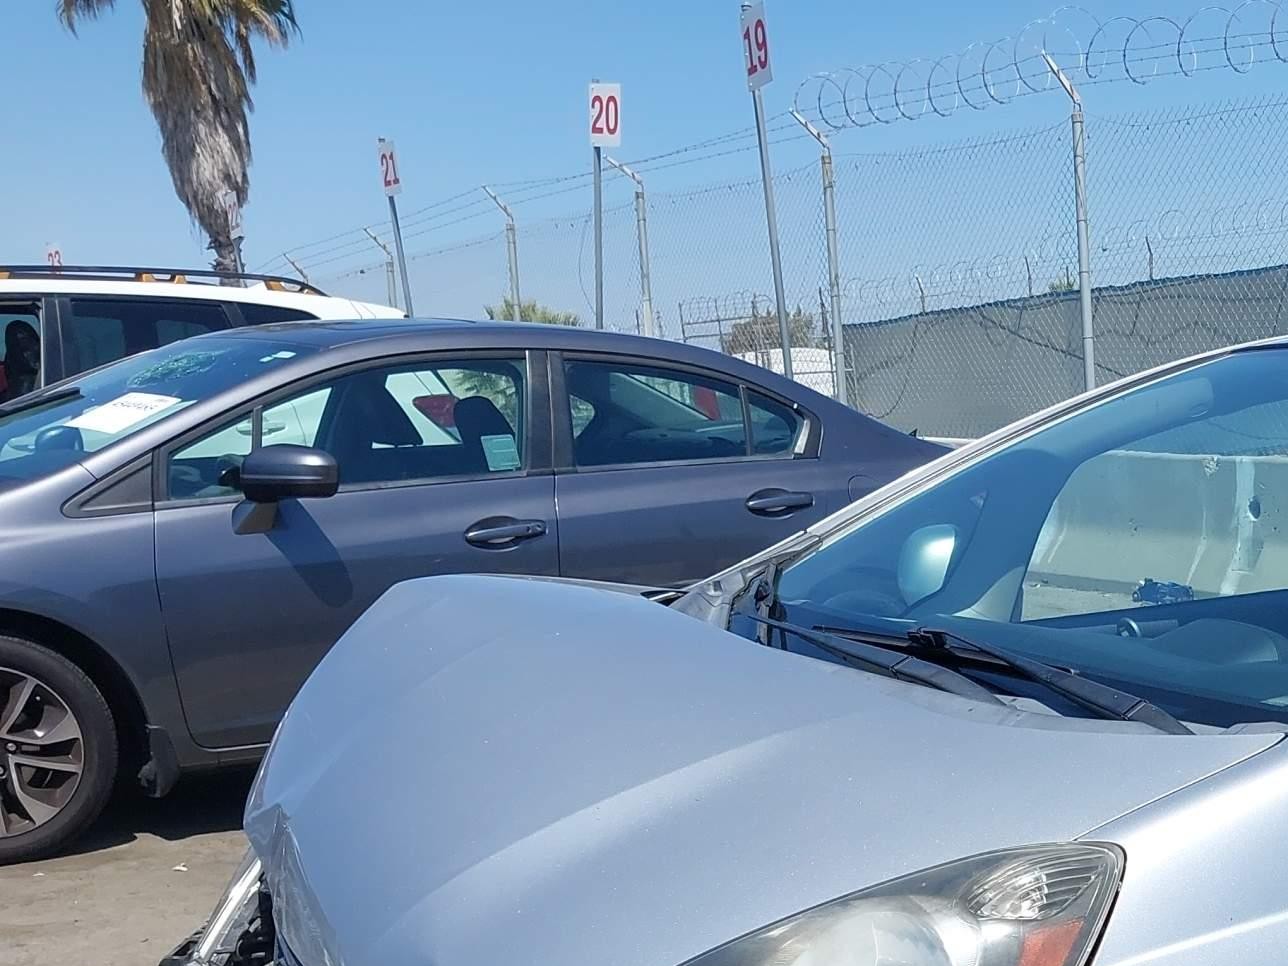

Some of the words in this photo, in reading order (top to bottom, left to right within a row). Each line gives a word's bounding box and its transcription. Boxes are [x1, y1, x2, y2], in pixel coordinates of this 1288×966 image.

[743, 19, 768, 76] 19
[592, 95, 619, 135] 20
[381, 152, 400, 187] 21
